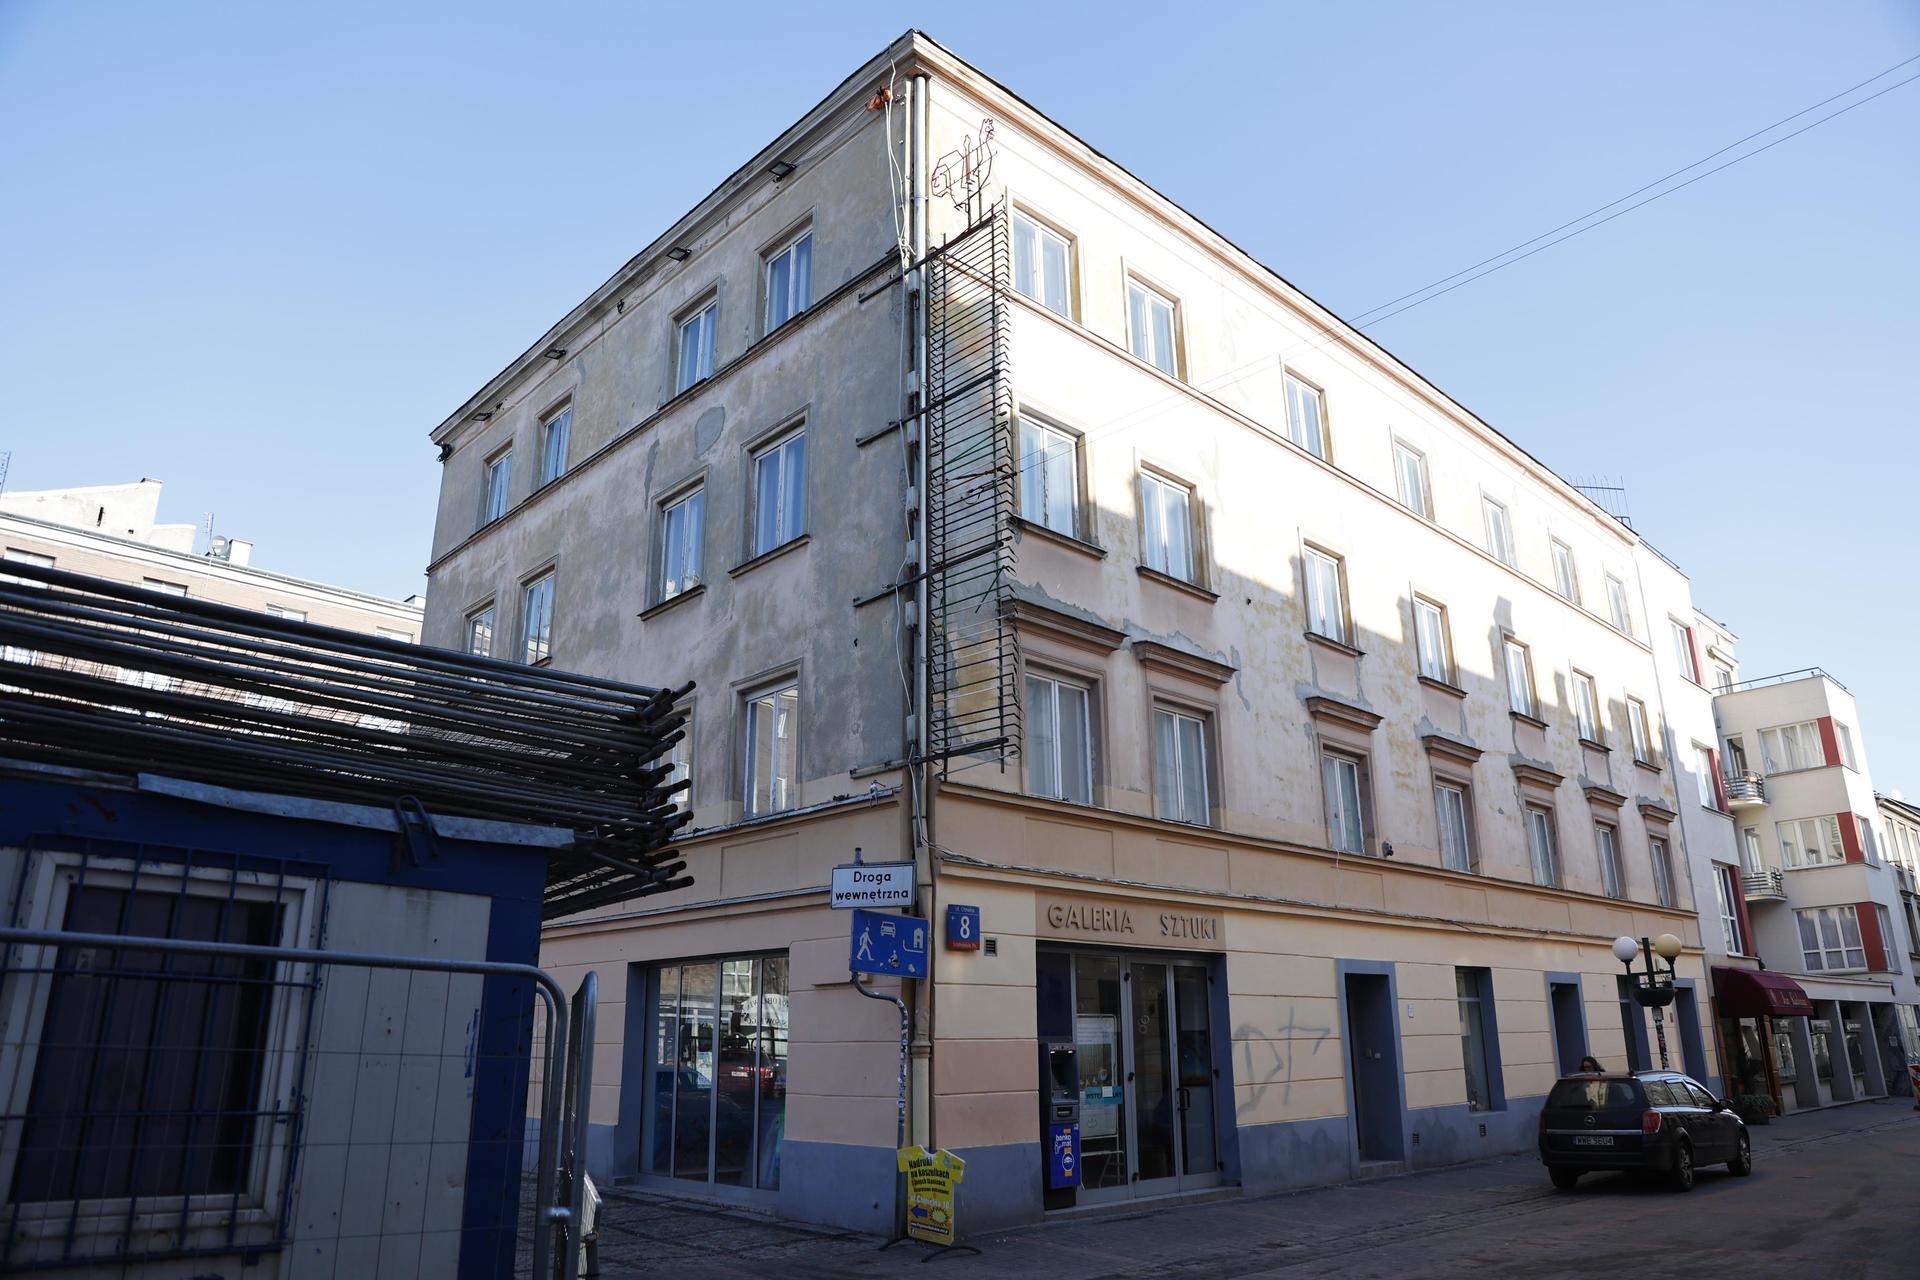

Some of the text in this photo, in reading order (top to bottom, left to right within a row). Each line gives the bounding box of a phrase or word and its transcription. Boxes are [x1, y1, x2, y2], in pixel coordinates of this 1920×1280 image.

[853, 871, 892, 885] Droga
[835, 888, 909, 903] wewnętrzna
[959, 915, 970, 939] 8
[1047, 903, 1217, 940] GALERIA SZTUKI
[1055, 1134, 1072, 1142] banko
[909, 1157, 933, 1170] Nadruki
